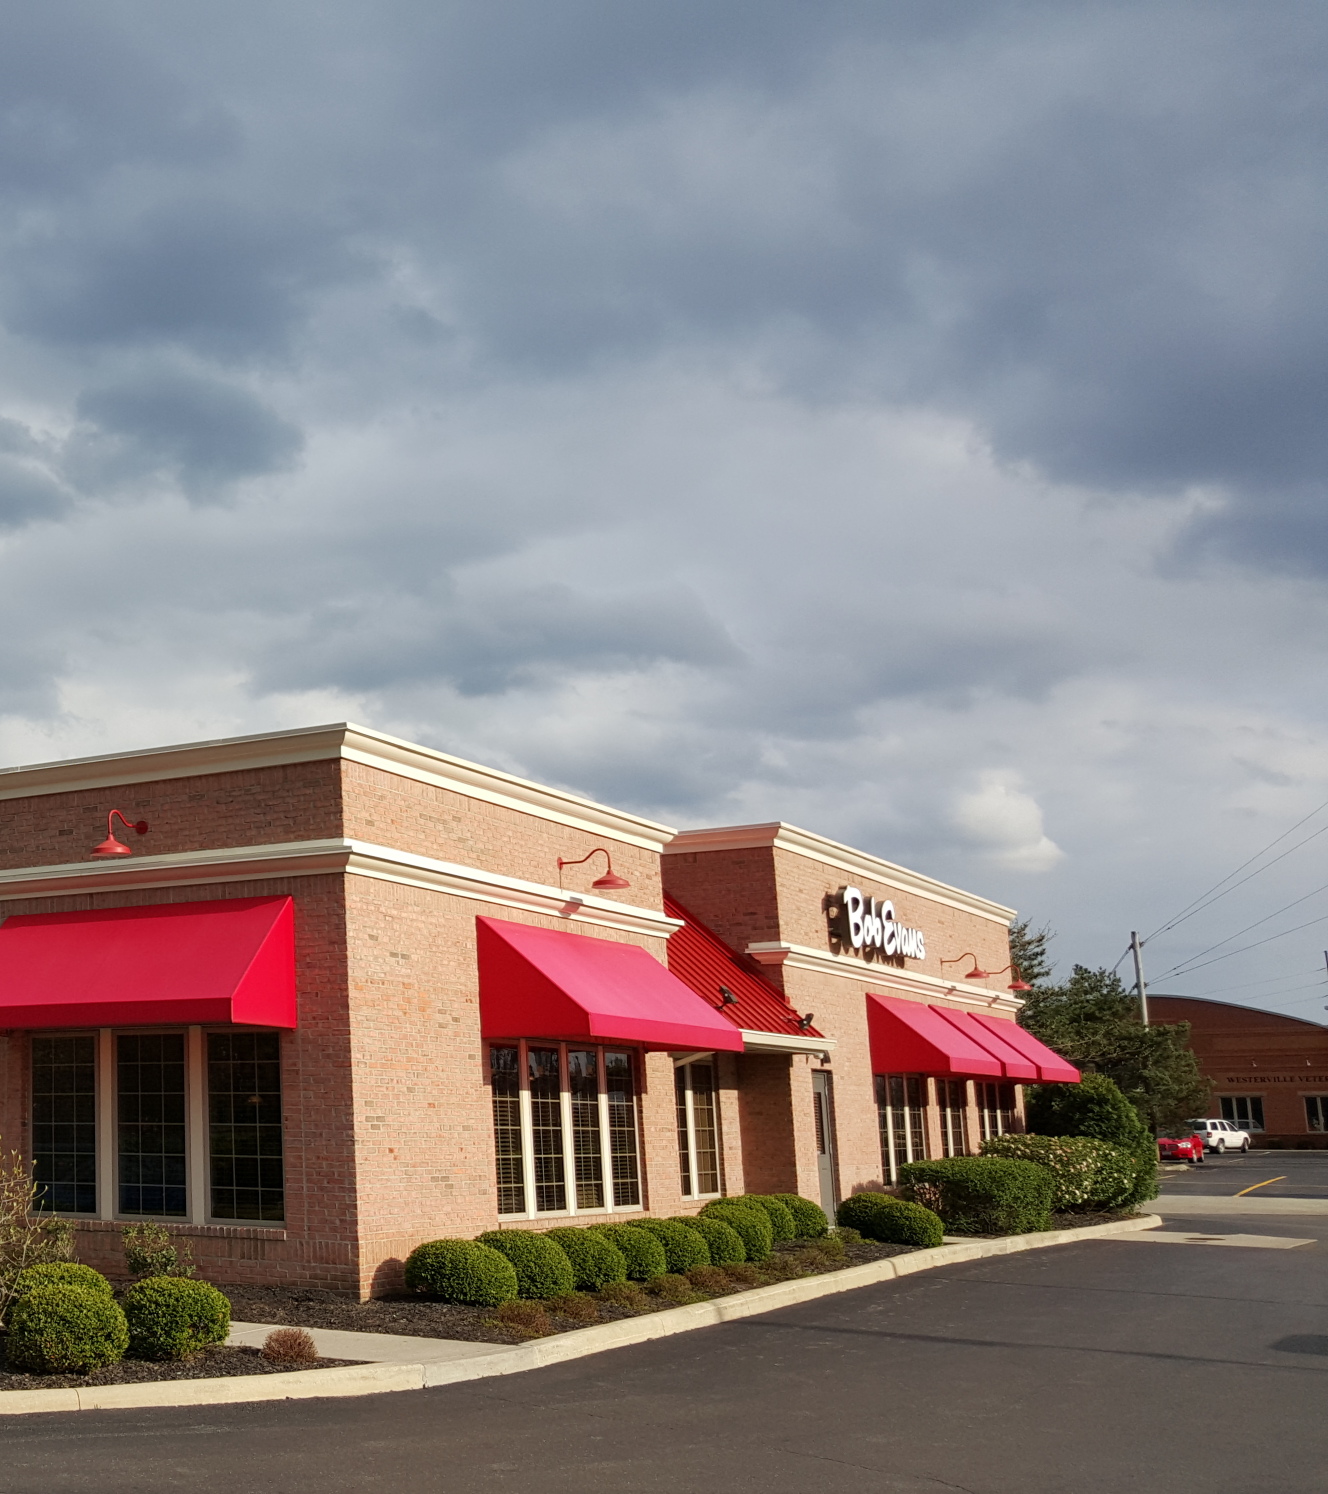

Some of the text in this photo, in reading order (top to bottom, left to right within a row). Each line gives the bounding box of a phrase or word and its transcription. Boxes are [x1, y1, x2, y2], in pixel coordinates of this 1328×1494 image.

[843, 885, 926, 960] Bob Evans
[1226, 1076, 1295, 1084] WESTERVILLE
